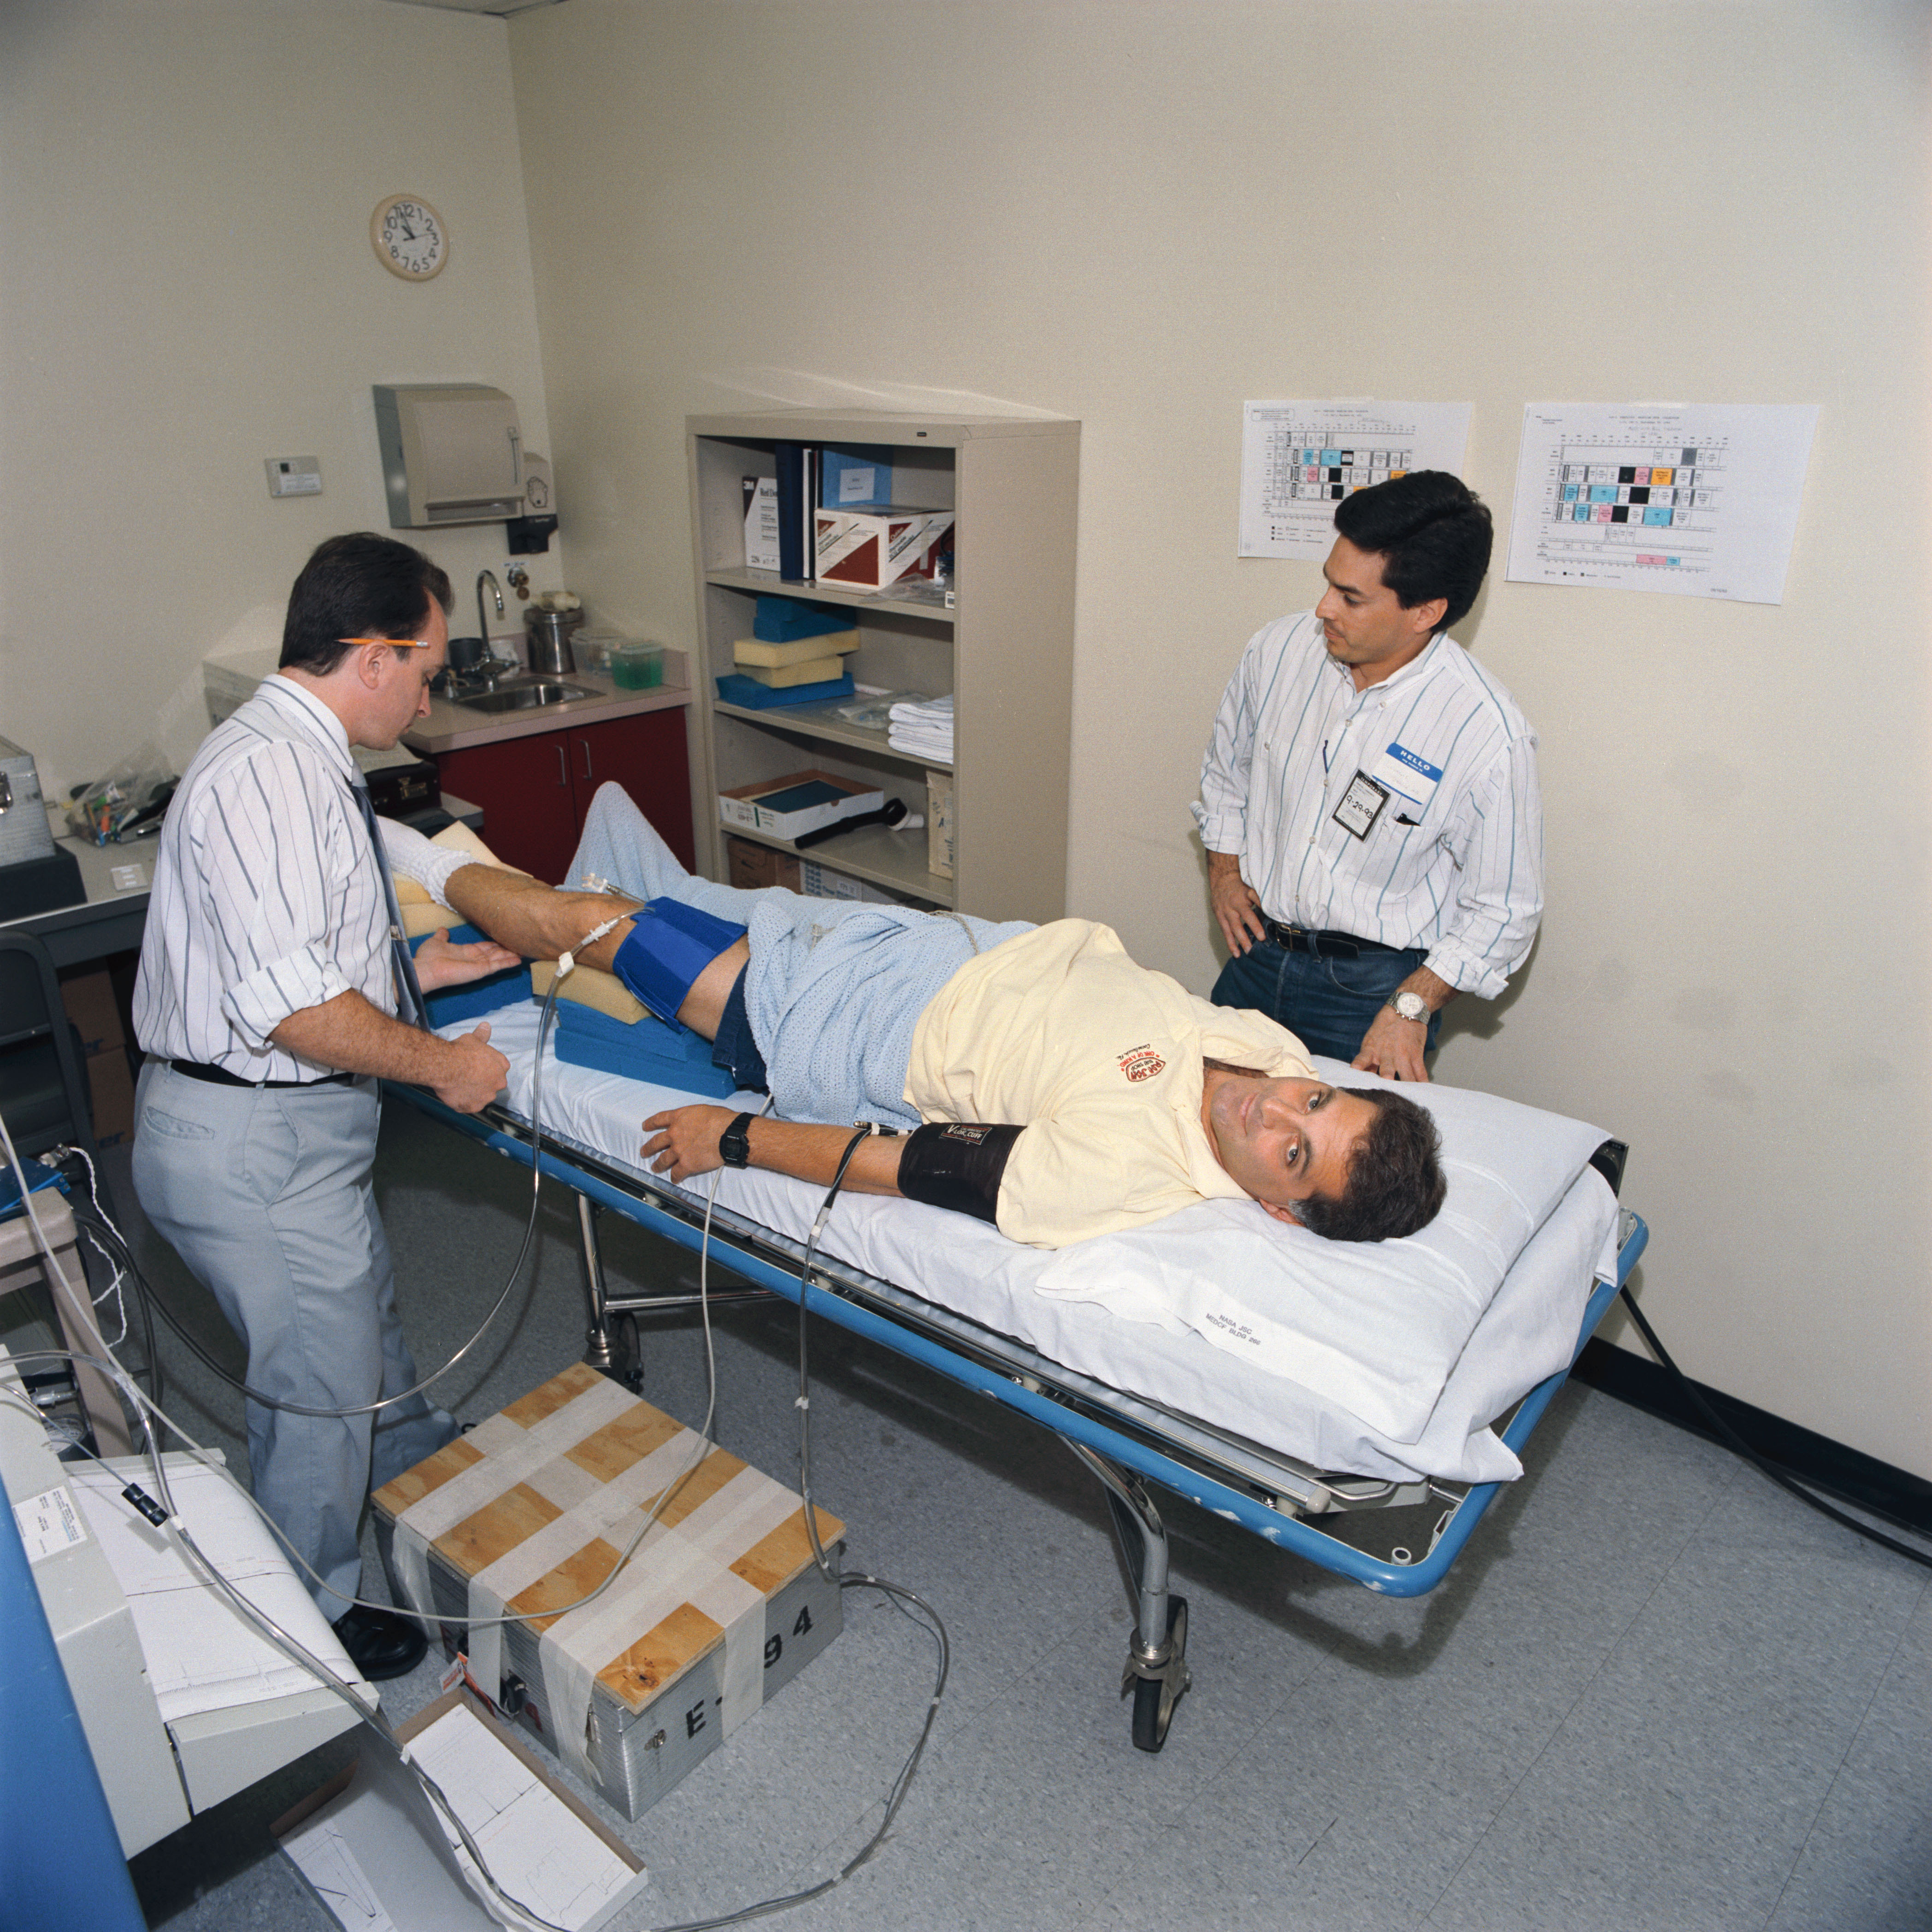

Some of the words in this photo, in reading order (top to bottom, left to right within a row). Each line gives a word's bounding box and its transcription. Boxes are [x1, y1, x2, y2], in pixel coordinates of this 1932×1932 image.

[402, 204, 414, 217] 12
[417, 207, 423, 221] 1
[386, 216, 397, 229] 10
[425, 218, 434, 231] 2
[383, 230, 393, 243] 9
[431, 232, 439, 246] 3
[390, 245, 399, 258] 8
[429, 248, 436, 259] 4
[402, 256, 409, 269] 7
[412, 260, 420, 272] 6
[422, 257, 430, 270] 5
[743, 481, 754, 490] 3M
[1400, 750, 1430, 770] HELLO
[1361, 777, 1383, 796] TEMPORARY
[1119, 1057, 1133, 1067] KIND
[1131, 1062, 1144, 1071] SHOP
[1131, 1068, 1147, 1080] JON
[1219, 1315, 1237, 1328] NASA
[1239, 1325, 1253, 1335] JSC
[1229, 1328, 1247, 1339] BLDG
